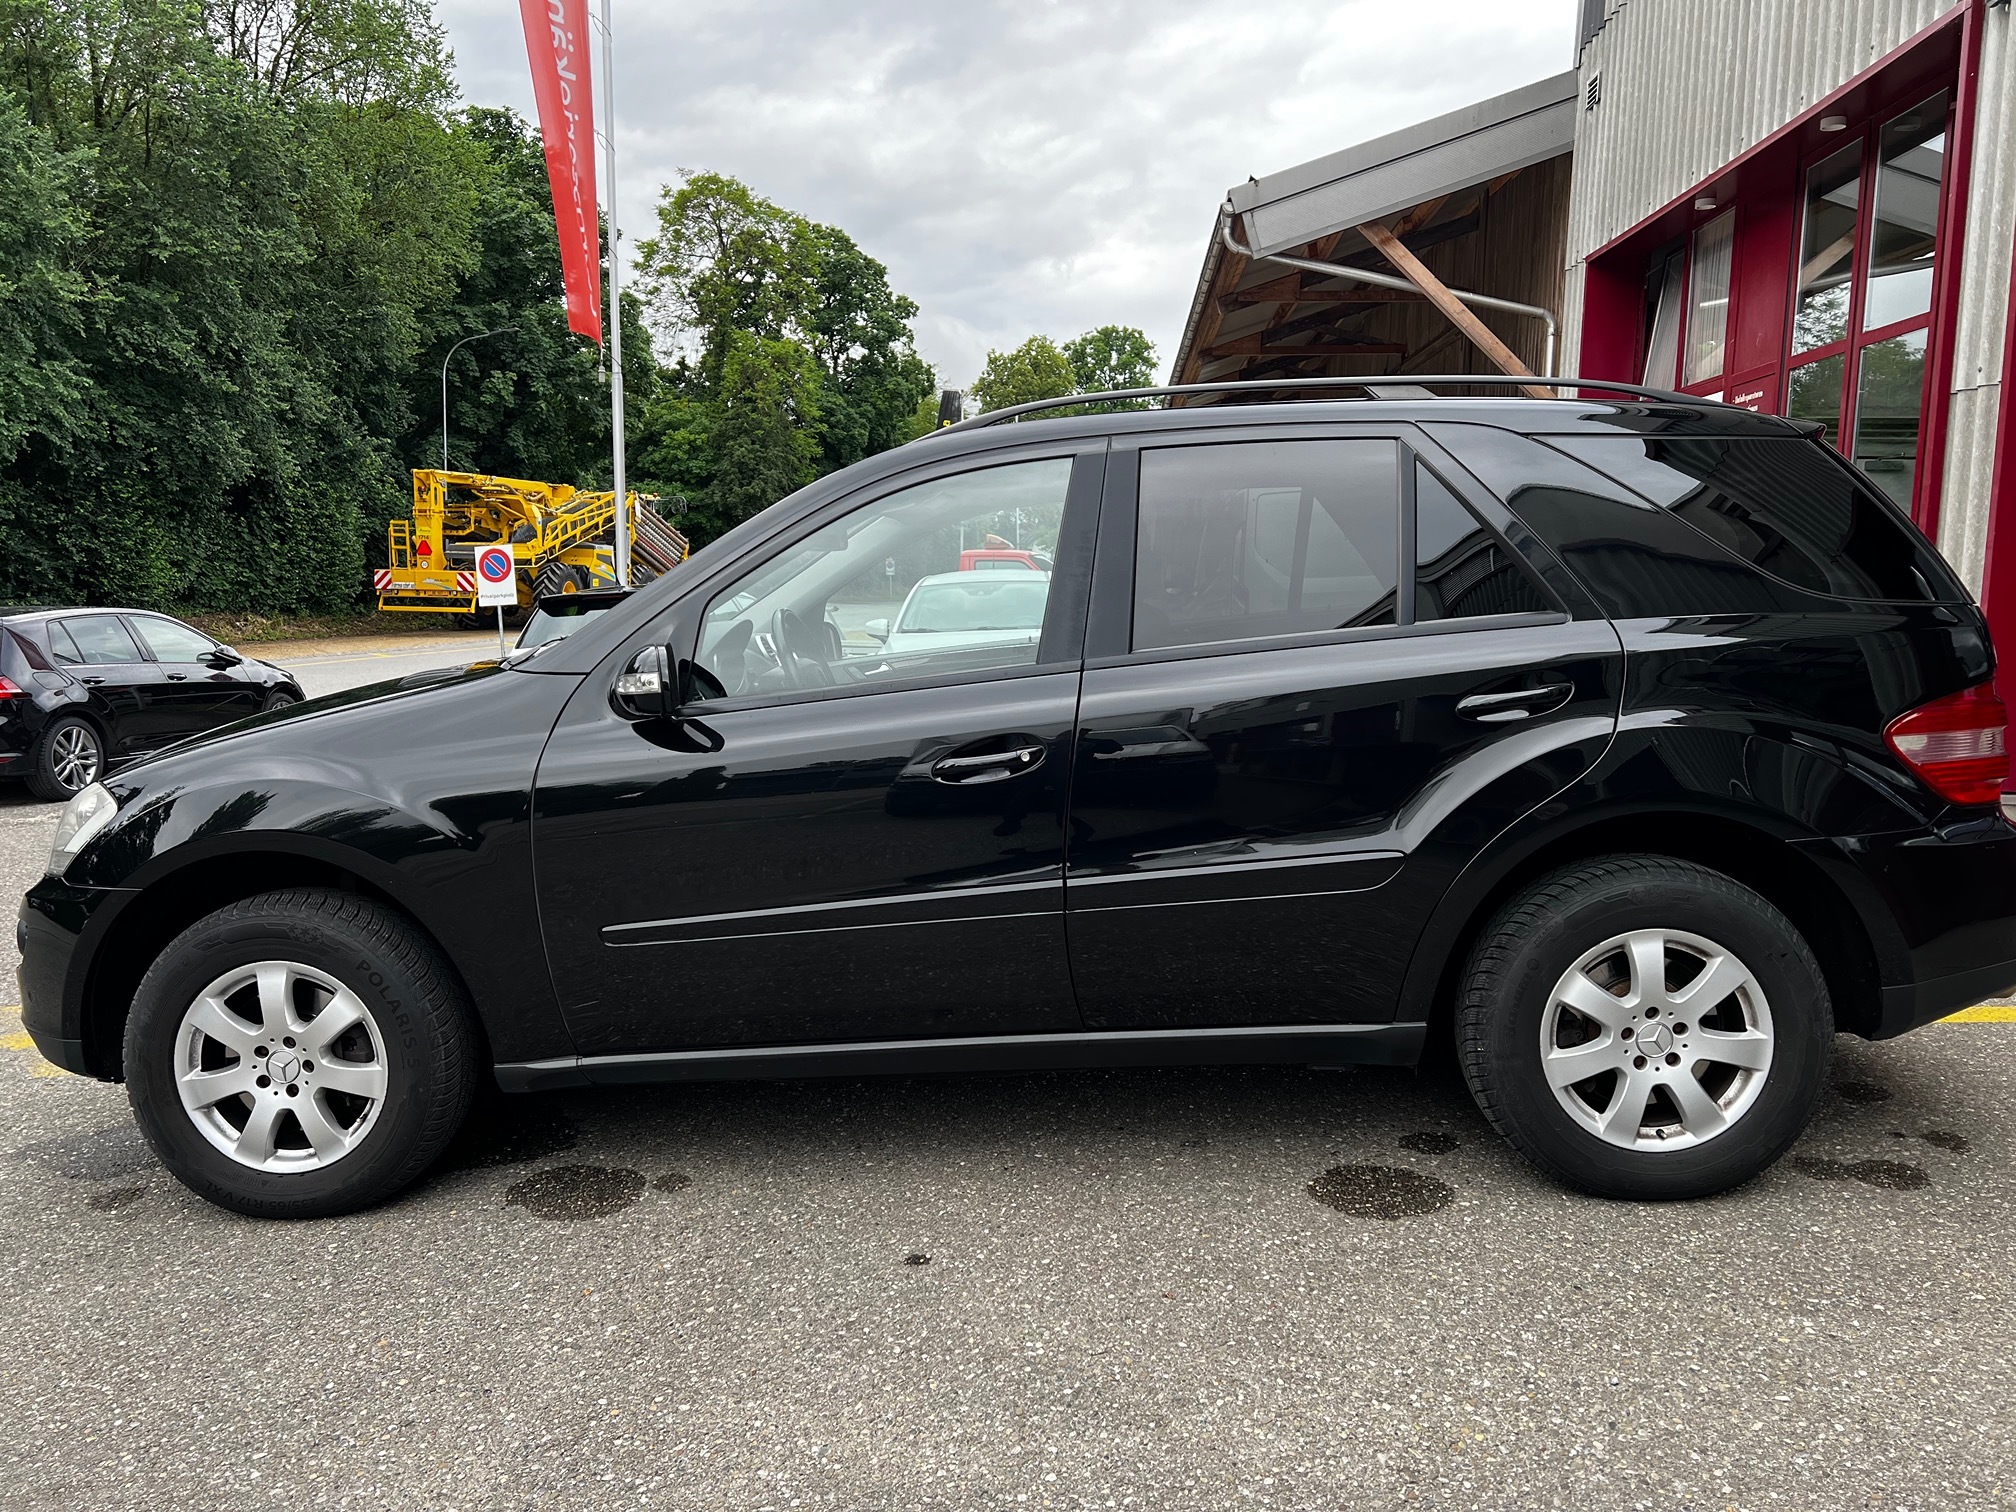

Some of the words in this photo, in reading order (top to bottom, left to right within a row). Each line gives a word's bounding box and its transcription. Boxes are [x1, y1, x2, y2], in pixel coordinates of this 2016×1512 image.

[356, 960, 417, 1049] POLARIS
[407, 1058, 420, 1069] 5
[205, 1179, 222, 1194] XL
[238, 1196, 264, 1209] R17
[269, 1197, 321, 1211] 235/65
